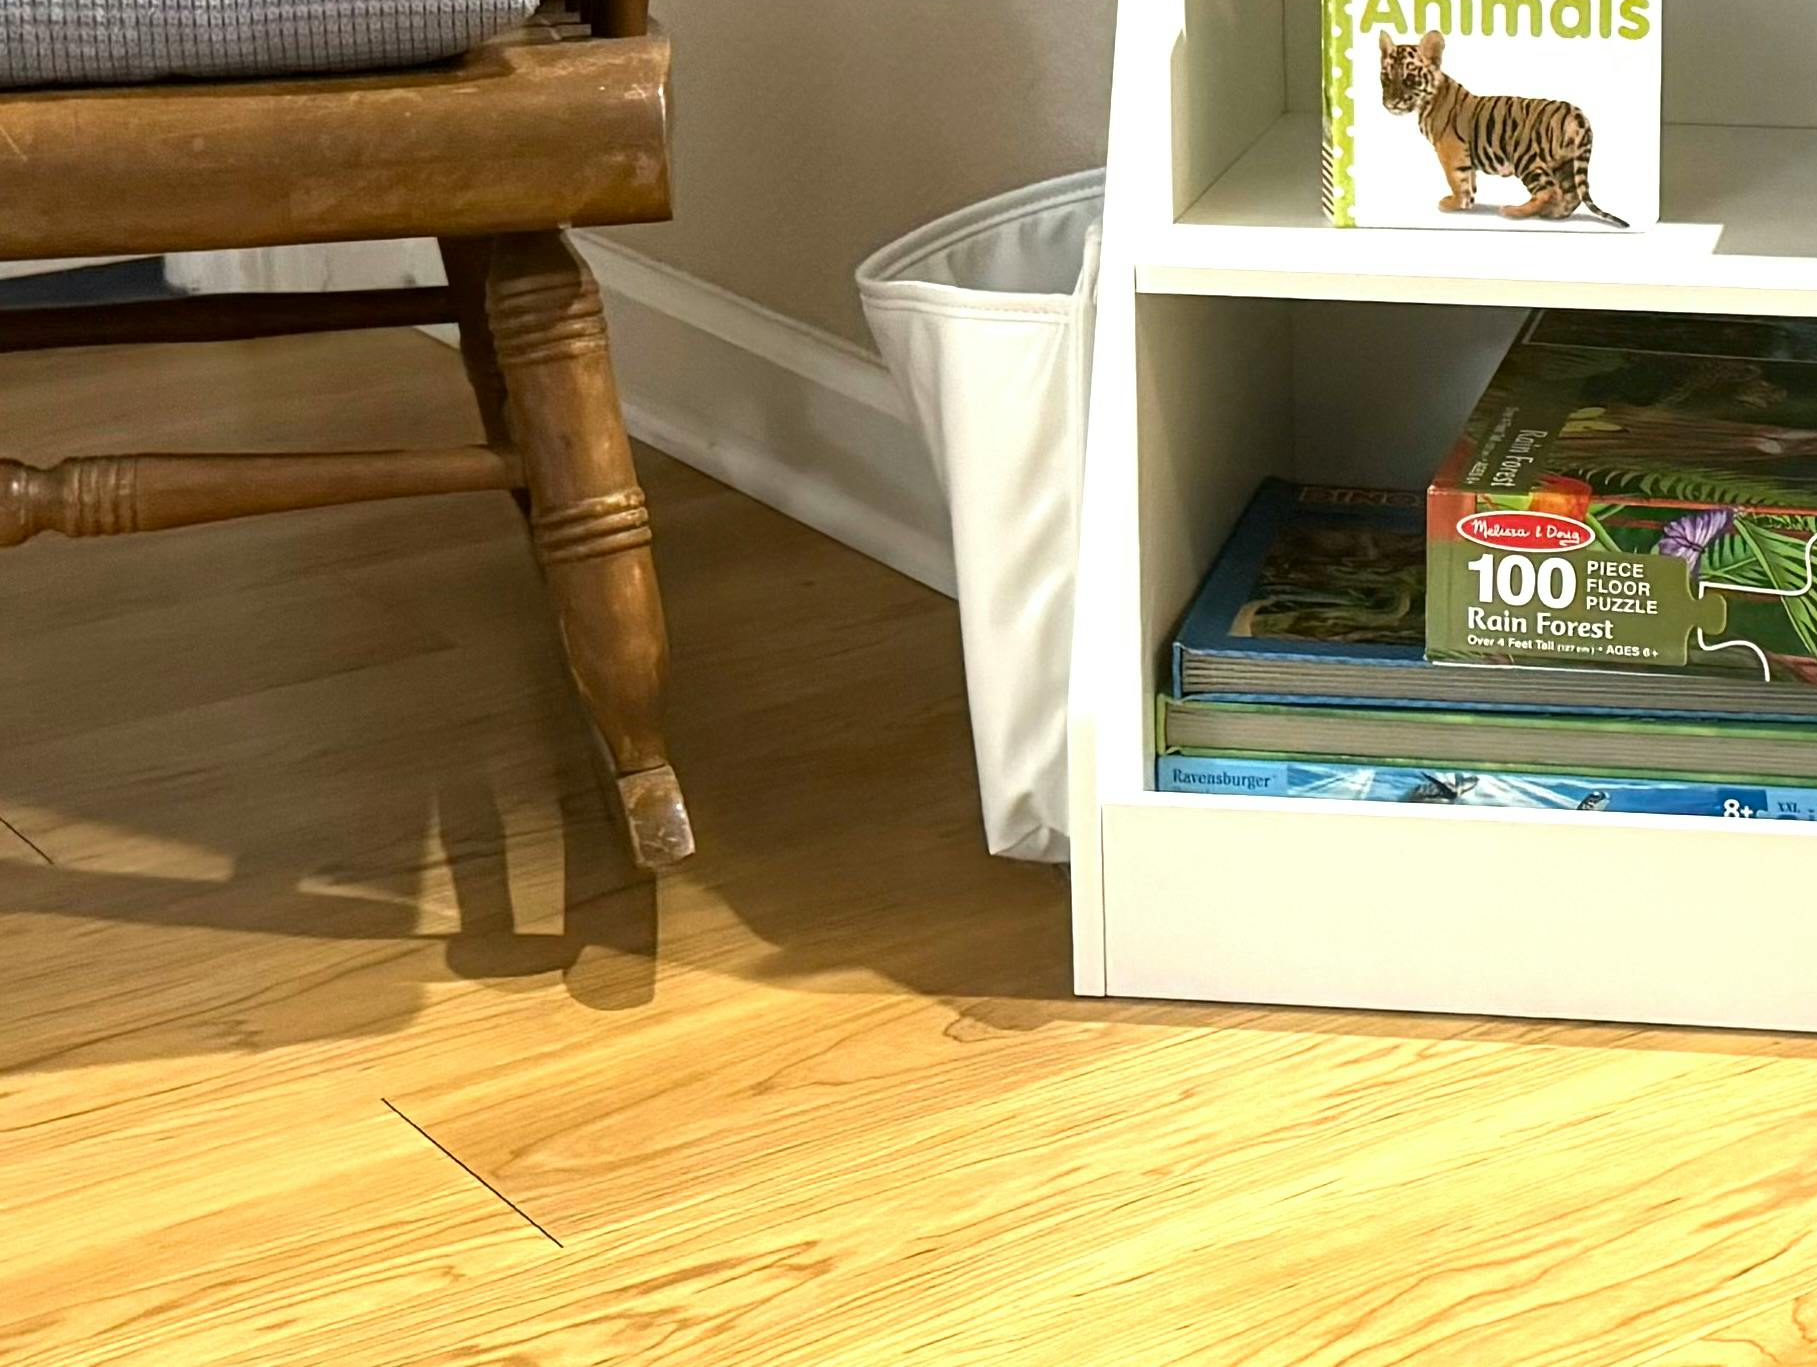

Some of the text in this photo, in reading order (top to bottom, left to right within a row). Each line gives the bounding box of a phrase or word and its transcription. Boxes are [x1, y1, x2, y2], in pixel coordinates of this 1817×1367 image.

[1509, 429, 1549, 453] Rain
[1471, 519, 1582, 546] Melissa Doug
[1587, 560, 1645, 578] PIECE
[1467, 553, 1577, 609] 100
[1586, 578, 1651, 597] FLOOR
[1586, 596, 1658, 615] PUZZLE
[1467, 606, 1614, 639] Rain Forest
[1467, 635, 1495, 647] Over
[1508, 637, 1532, 649] Feet
[1535, 639, 1555, 651] Tall
[1606, 645, 1641, 657] AGES
[1173, 768, 1271, 790] Ravensburger
